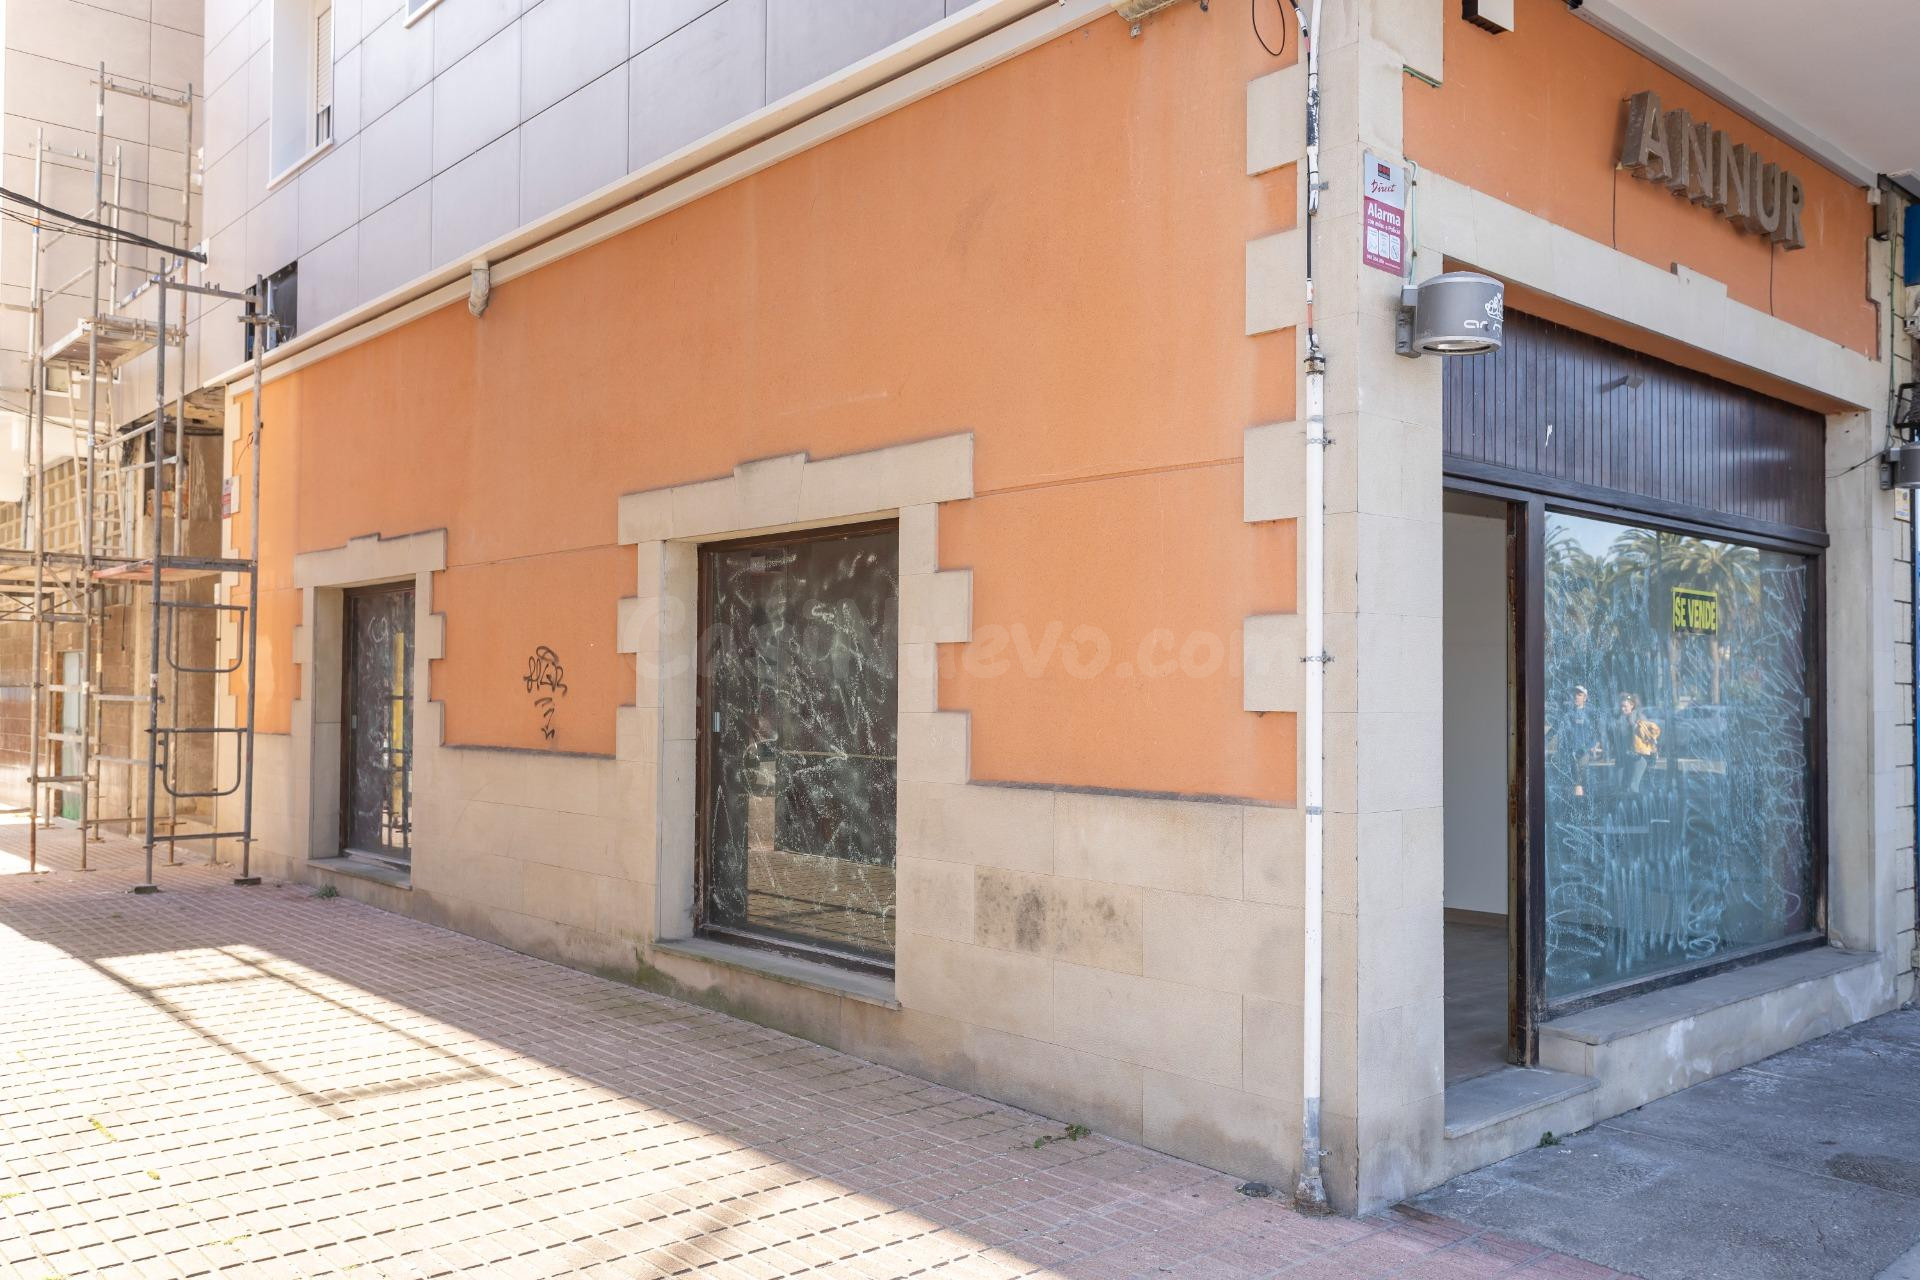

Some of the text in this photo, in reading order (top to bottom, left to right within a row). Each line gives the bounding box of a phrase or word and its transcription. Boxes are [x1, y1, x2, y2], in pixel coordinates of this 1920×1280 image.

[1621, 90, 1805, 249] ANNUR
[1367, 202, 1401, 227] Alarma
[1675, 596, 1716, 631] SE VENDE
